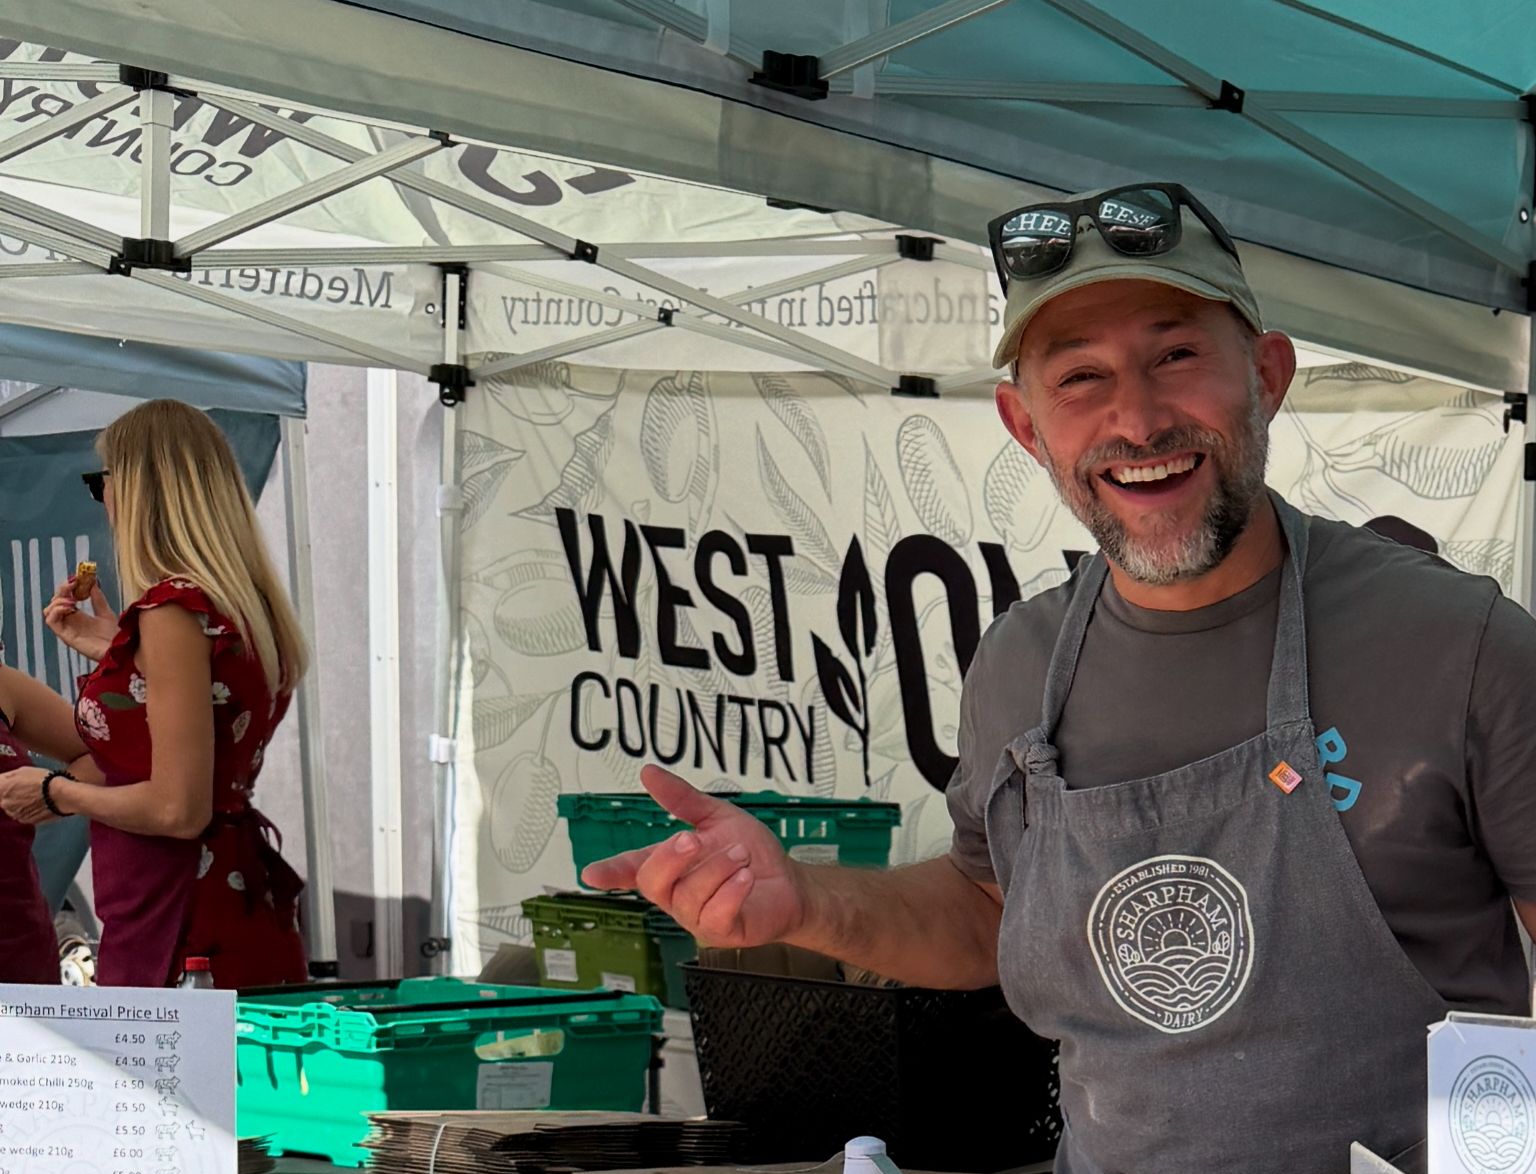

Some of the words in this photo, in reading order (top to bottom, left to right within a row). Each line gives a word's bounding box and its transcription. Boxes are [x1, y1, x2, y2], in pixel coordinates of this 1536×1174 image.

[555, 508, 795, 682] WEST
[569, 671, 816, 786] COUNTRY
[1112, 864, 1187, 895] ESTABLISHED
[1116, 884, 1228, 941] SHARPHAM
[60, 1003, 112, 1019] Festival
[117, 1005, 152, 1020] Price
[156, 1006, 179, 1021] List
[1162, 1008, 1205, 1029] DAIRY
[115, 1033, 146, 1044] £4.50
[16, 1053, 47, 1064] Garlic
[50, 1054, 77, 1067] 210g
[115, 1056, 146, 1067] £4.50
[38, 1077, 65, 1088] Chilli
[67, 1078, 94, 1090] 250g
[38, 1100, 65, 1112] 210g
[1464, 1076, 1525, 1119] SHARPHAM
[9, 1145, 45, 1158] wedge
[47, 1146, 74, 1159] 210g
